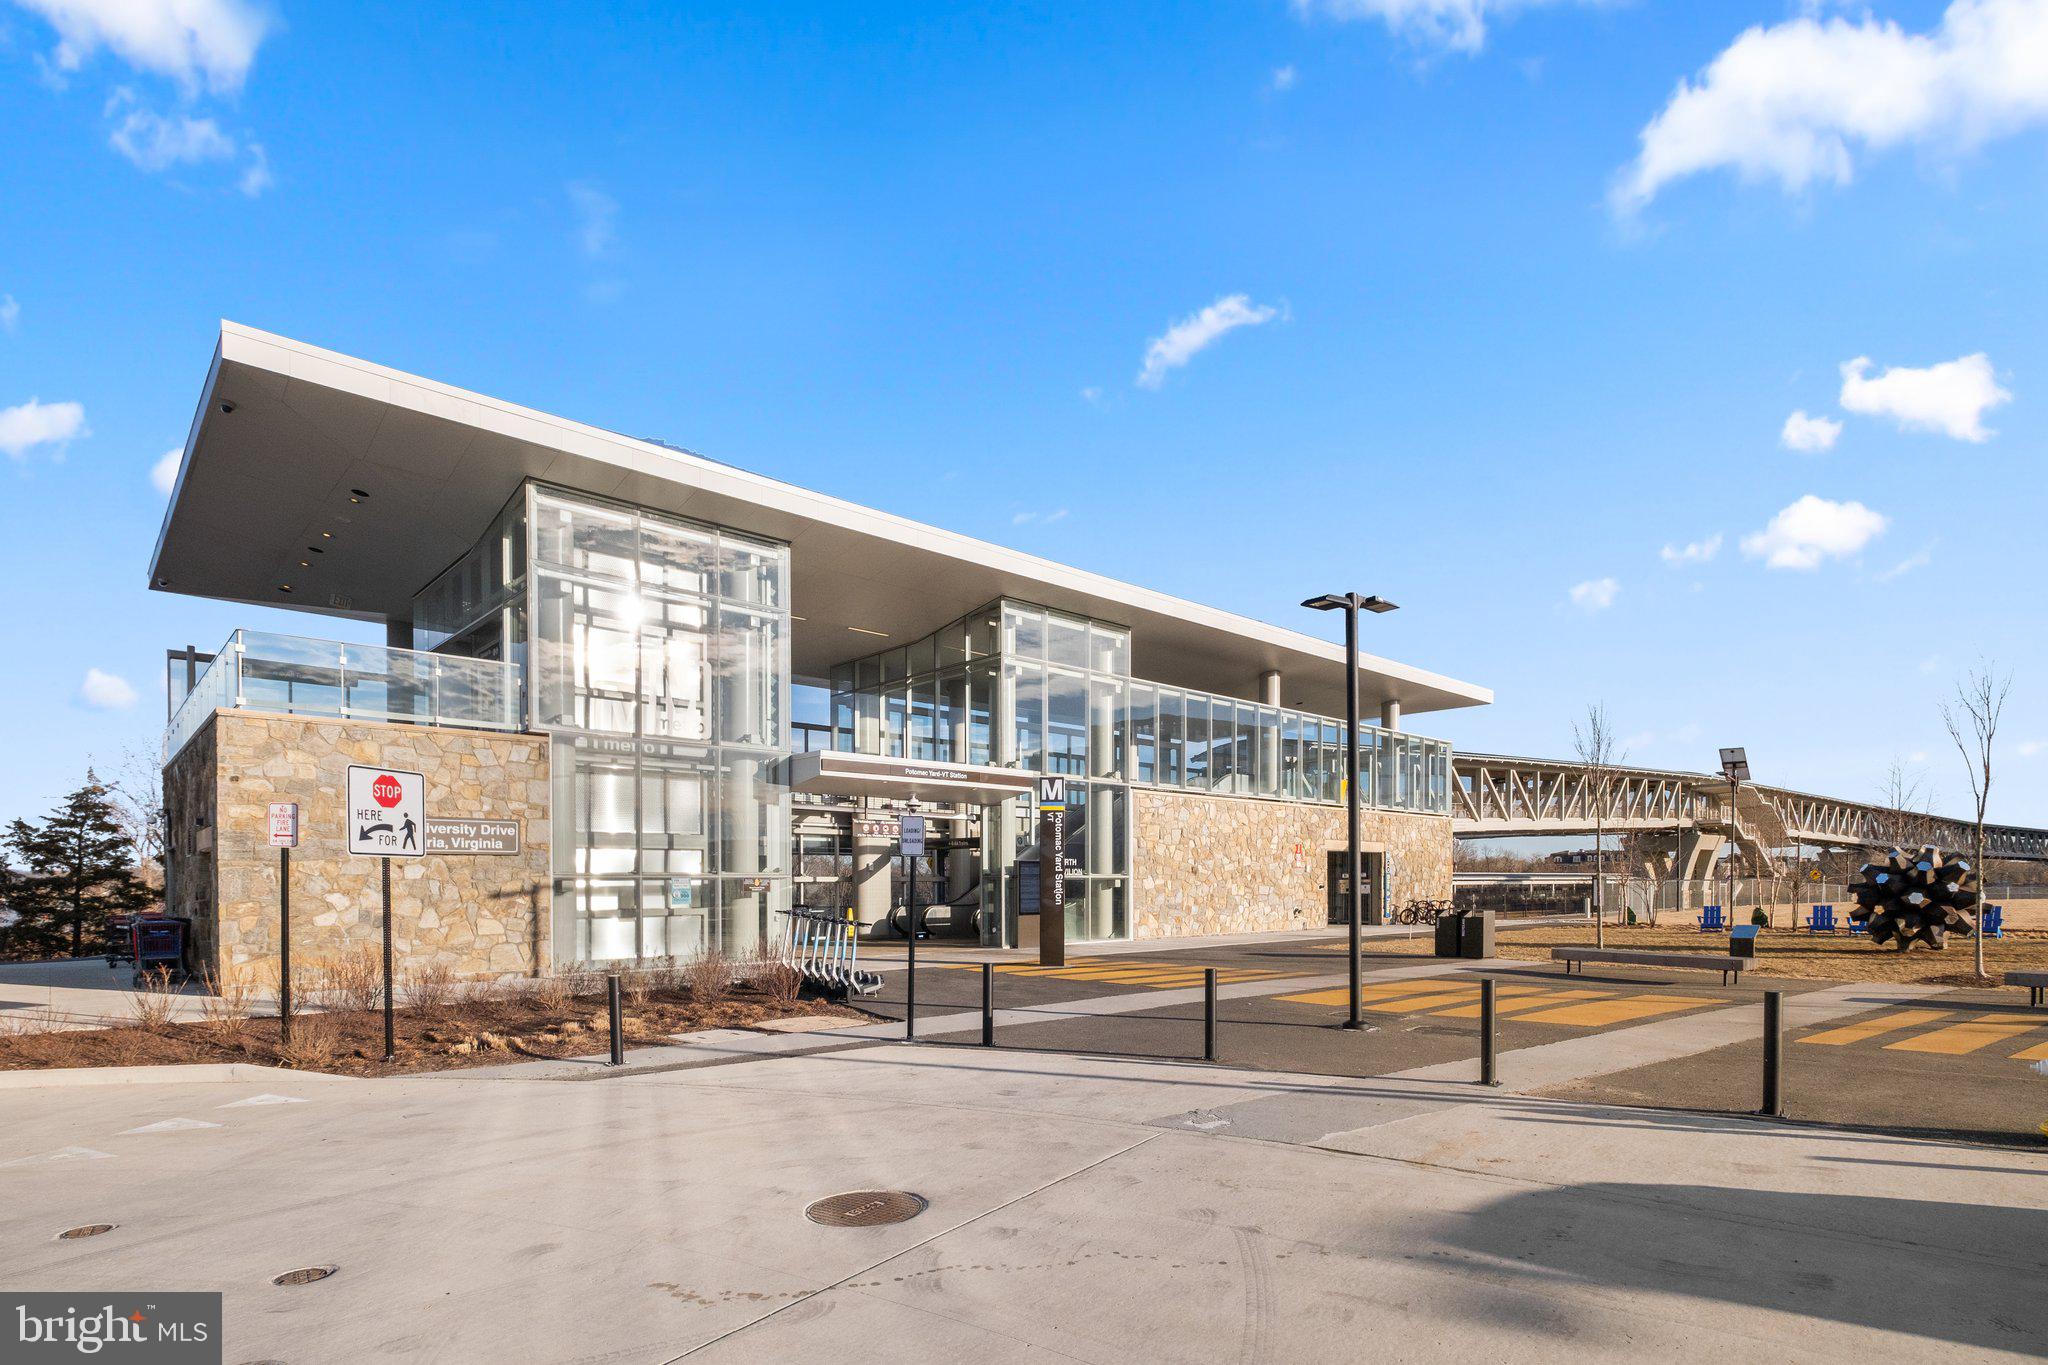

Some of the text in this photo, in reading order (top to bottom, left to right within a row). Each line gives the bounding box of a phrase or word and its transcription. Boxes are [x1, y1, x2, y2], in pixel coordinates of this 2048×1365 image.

[905, 768, 968, 780] Potomac Yard-VT Station
[373, 783, 401, 798] STOP
[1041, 779, 1062, 800] M
[357, 809, 383, 821] HERE
[1047, 812, 1054, 822] VT
[480, 824, 516, 836] Drive
[378, 835, 398, 846] FOR
[451, 837, 503, 851] Virginia
[1053, 812, 1064, 905] Potomac Yard Station
